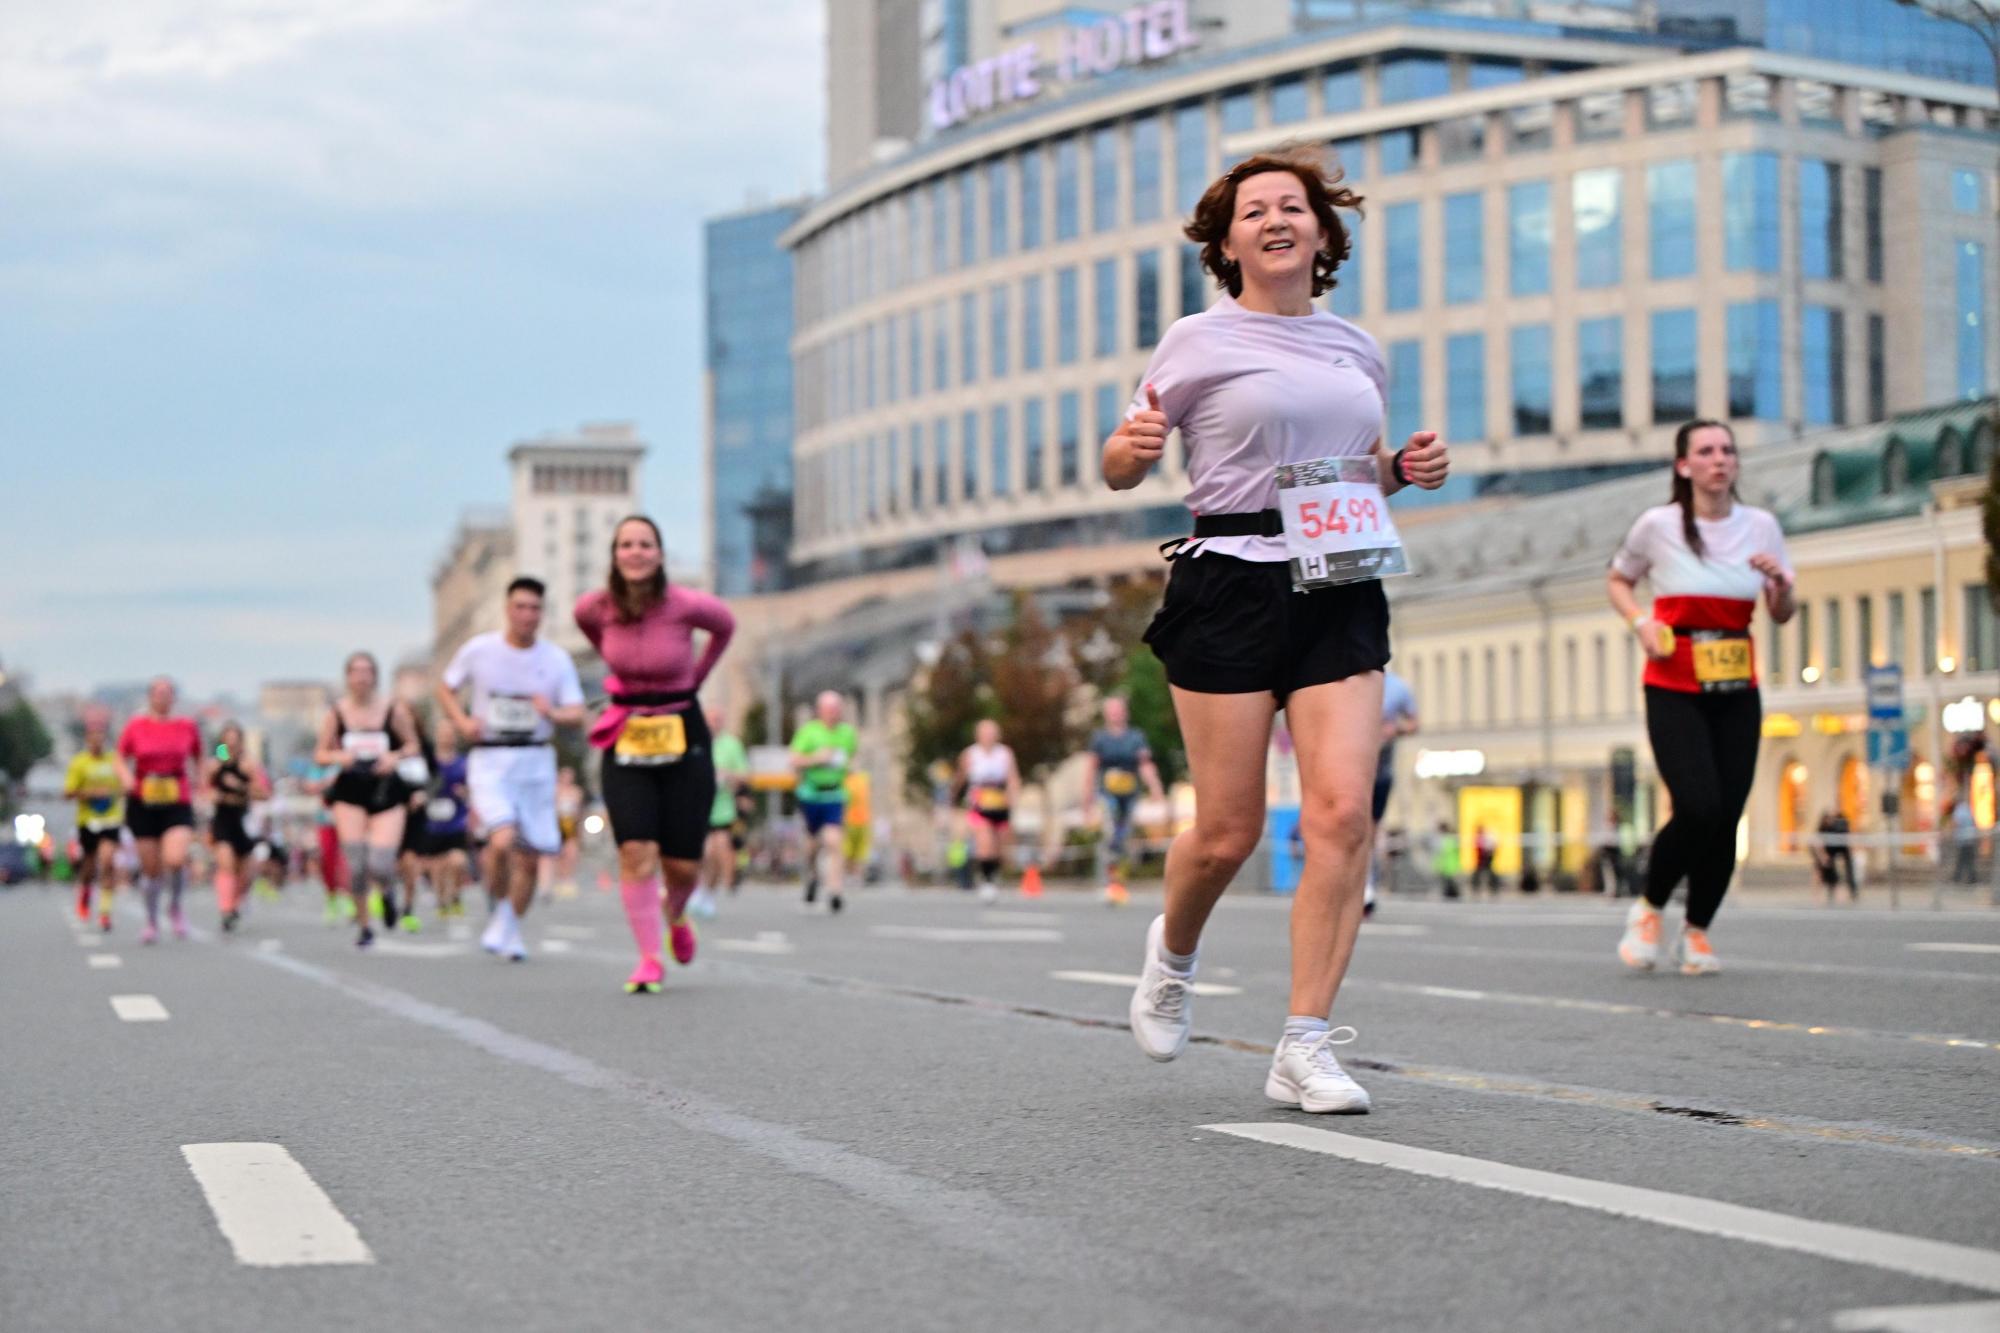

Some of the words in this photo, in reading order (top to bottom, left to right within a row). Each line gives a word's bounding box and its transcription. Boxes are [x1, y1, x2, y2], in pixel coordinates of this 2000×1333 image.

[931, 42, 1039, 128] LOTTE
[1057, 0, 1198, 81] HOTEL
[1298, 498, 1380, 539] 5499
